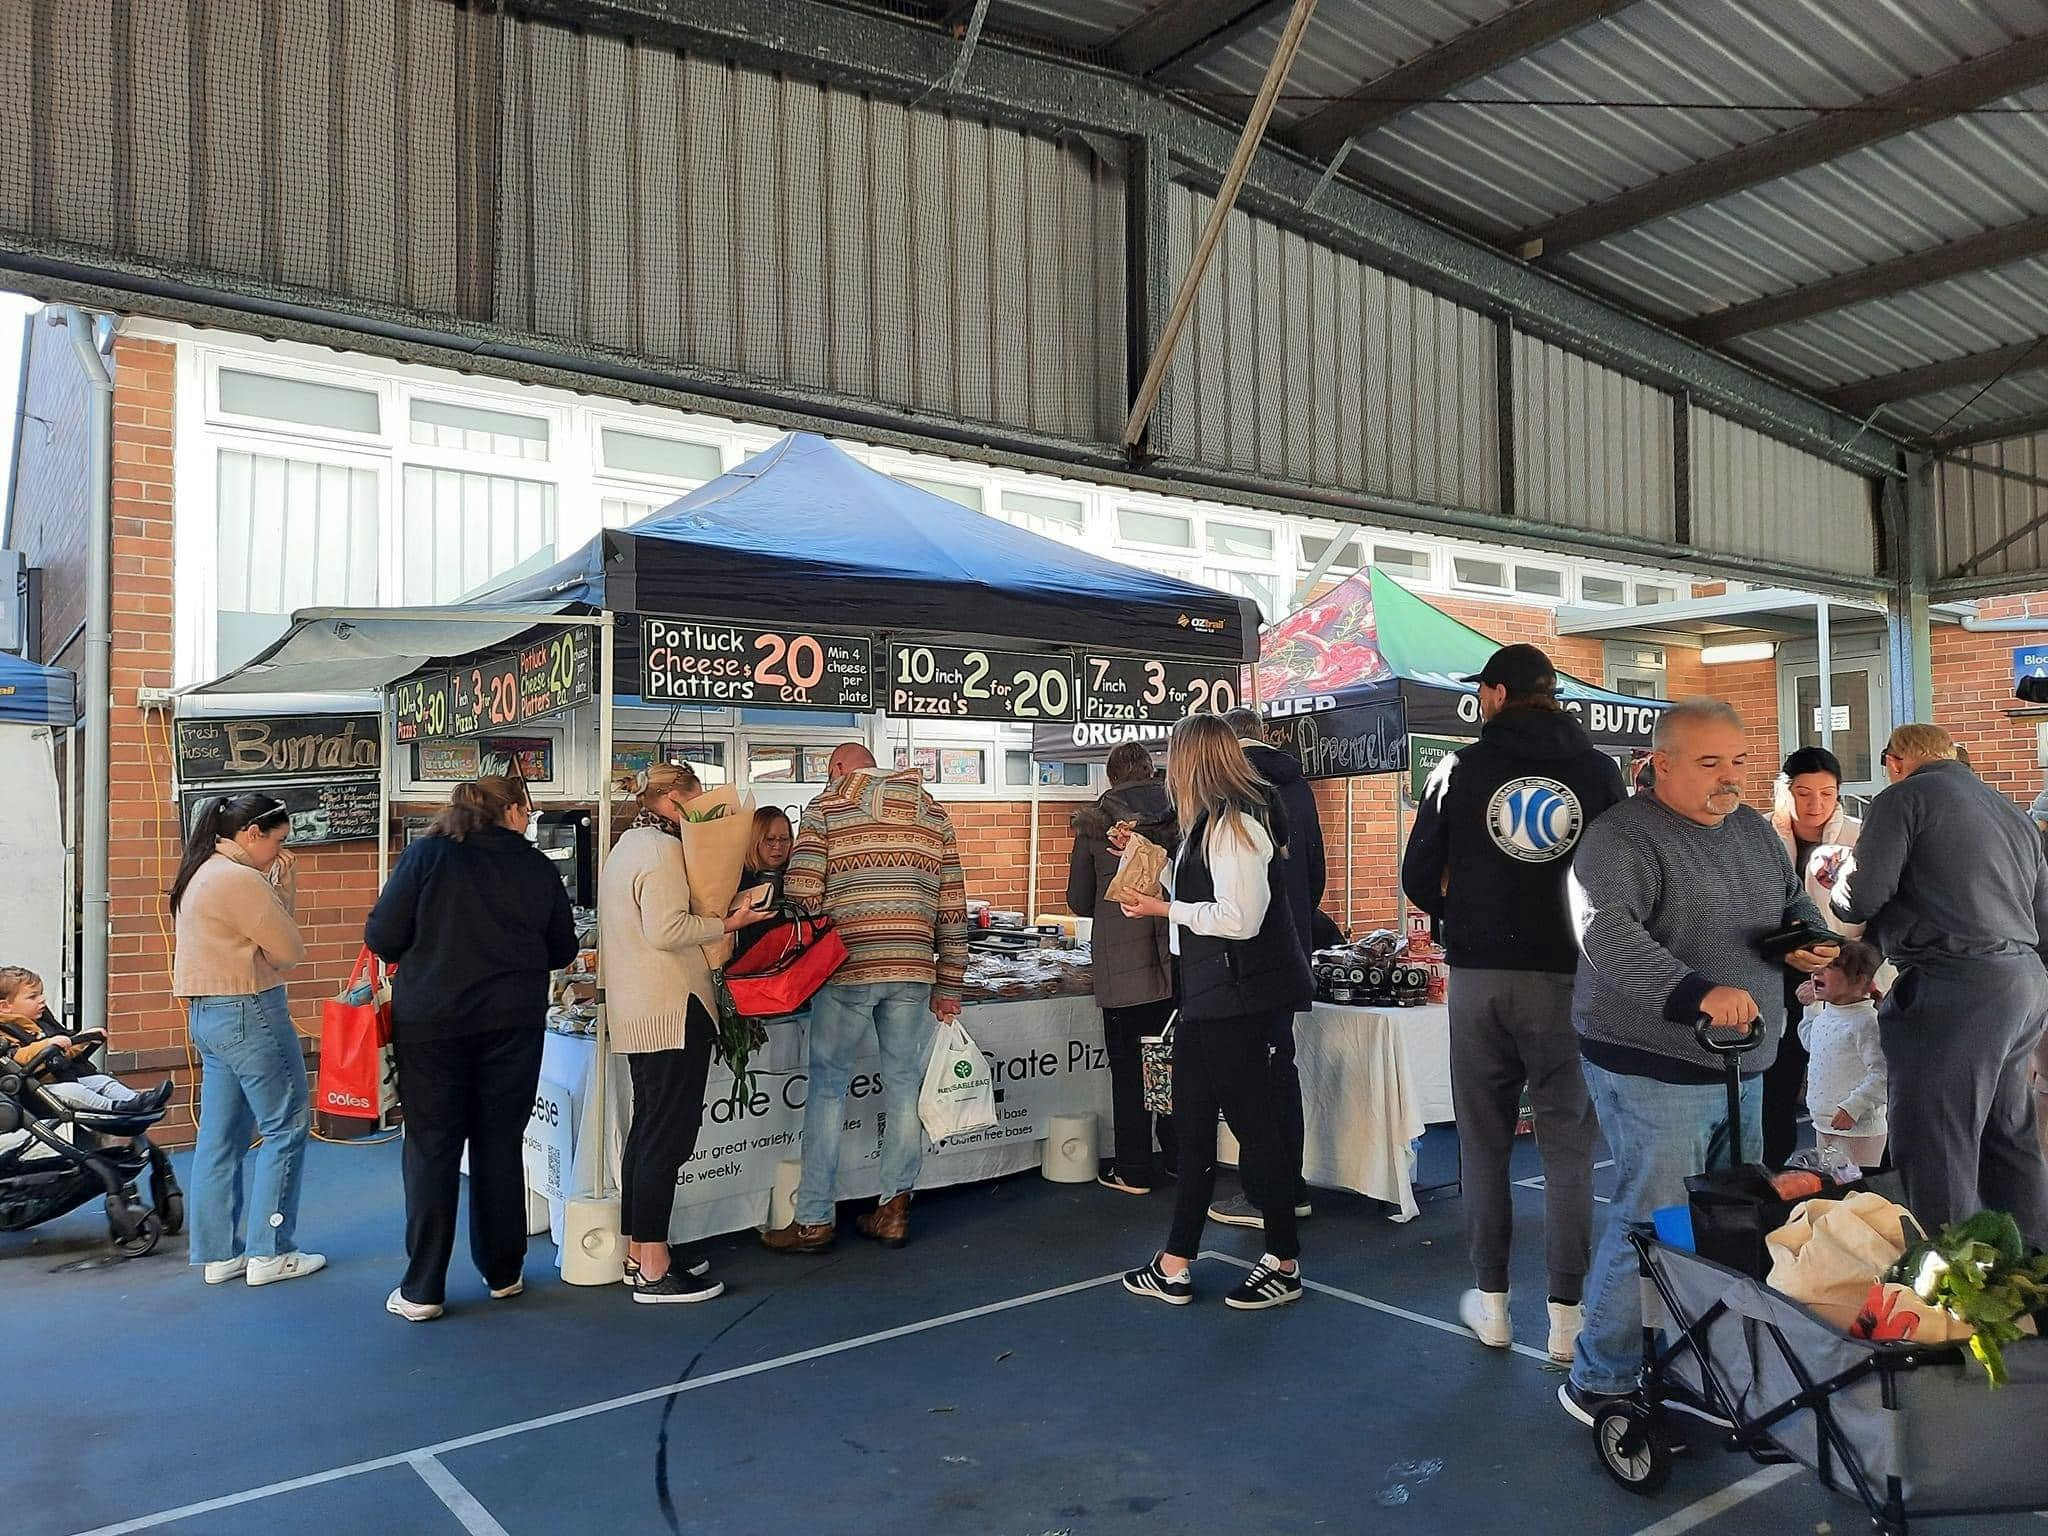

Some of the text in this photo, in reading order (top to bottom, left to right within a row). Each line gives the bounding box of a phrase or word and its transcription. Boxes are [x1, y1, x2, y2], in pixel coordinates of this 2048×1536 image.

[651, 622, 745, 653] Potluck
[520, 642, 547, 677] Potluck
[649, 647, 741, 676] Cheese
[828, 646, 861, 661] Min 4
[827, 661, 868, 674] cheese
[897, 648, 935, 684] 10
[935, 668, 963, 684] inch
[963, 652, 990, 699] 2
[989, 680, 1012, 696] for
[453, 676, 461, 708] 7
[472, 669, 482, 715] 3
[520, 672, 546, 697] Cheese
[651, 671, 813, 703] Platters ea.
[843, 675, 863, 688] per
[1089, 658, 1111, 691] 7
[1102, 678, 1127, 693] inch
[1143, 661, 1167, 705] 3
[1169, 688, 1188, 702] for
[398, 686, 409, 717] 10
[415, 682, 424, 723] 3
[521, 691, 550, 721] Platters
[839, 690, 868, 704] plate
[894, 689, 969, 714] Pizza's
[1087, 697, 1149, 719] Pizza's
[398, 720, 417, 739] Pizza's
[455, 710, 479, 733] Pizza's
[1590, 703, 1661, 735] BUTC
[181, 723, 219, 742] Fresh
[180, 742, 221, 760] Aussie
[223, 721, 377, 772] Burrata
[1068, 1039, 1110, 1073] Piz
[327, 1092, 370, 1108] coles
[1004, 1108, 1028, 1119] base
[984, 1125, 1003, 1140] free
[1005, 1125, 1033, 1137] bases
[711, 1138, 748, 1162] great
[750, 1130, 795, 1150] variety,
[699, 1161, 743, 1182] weekly.
